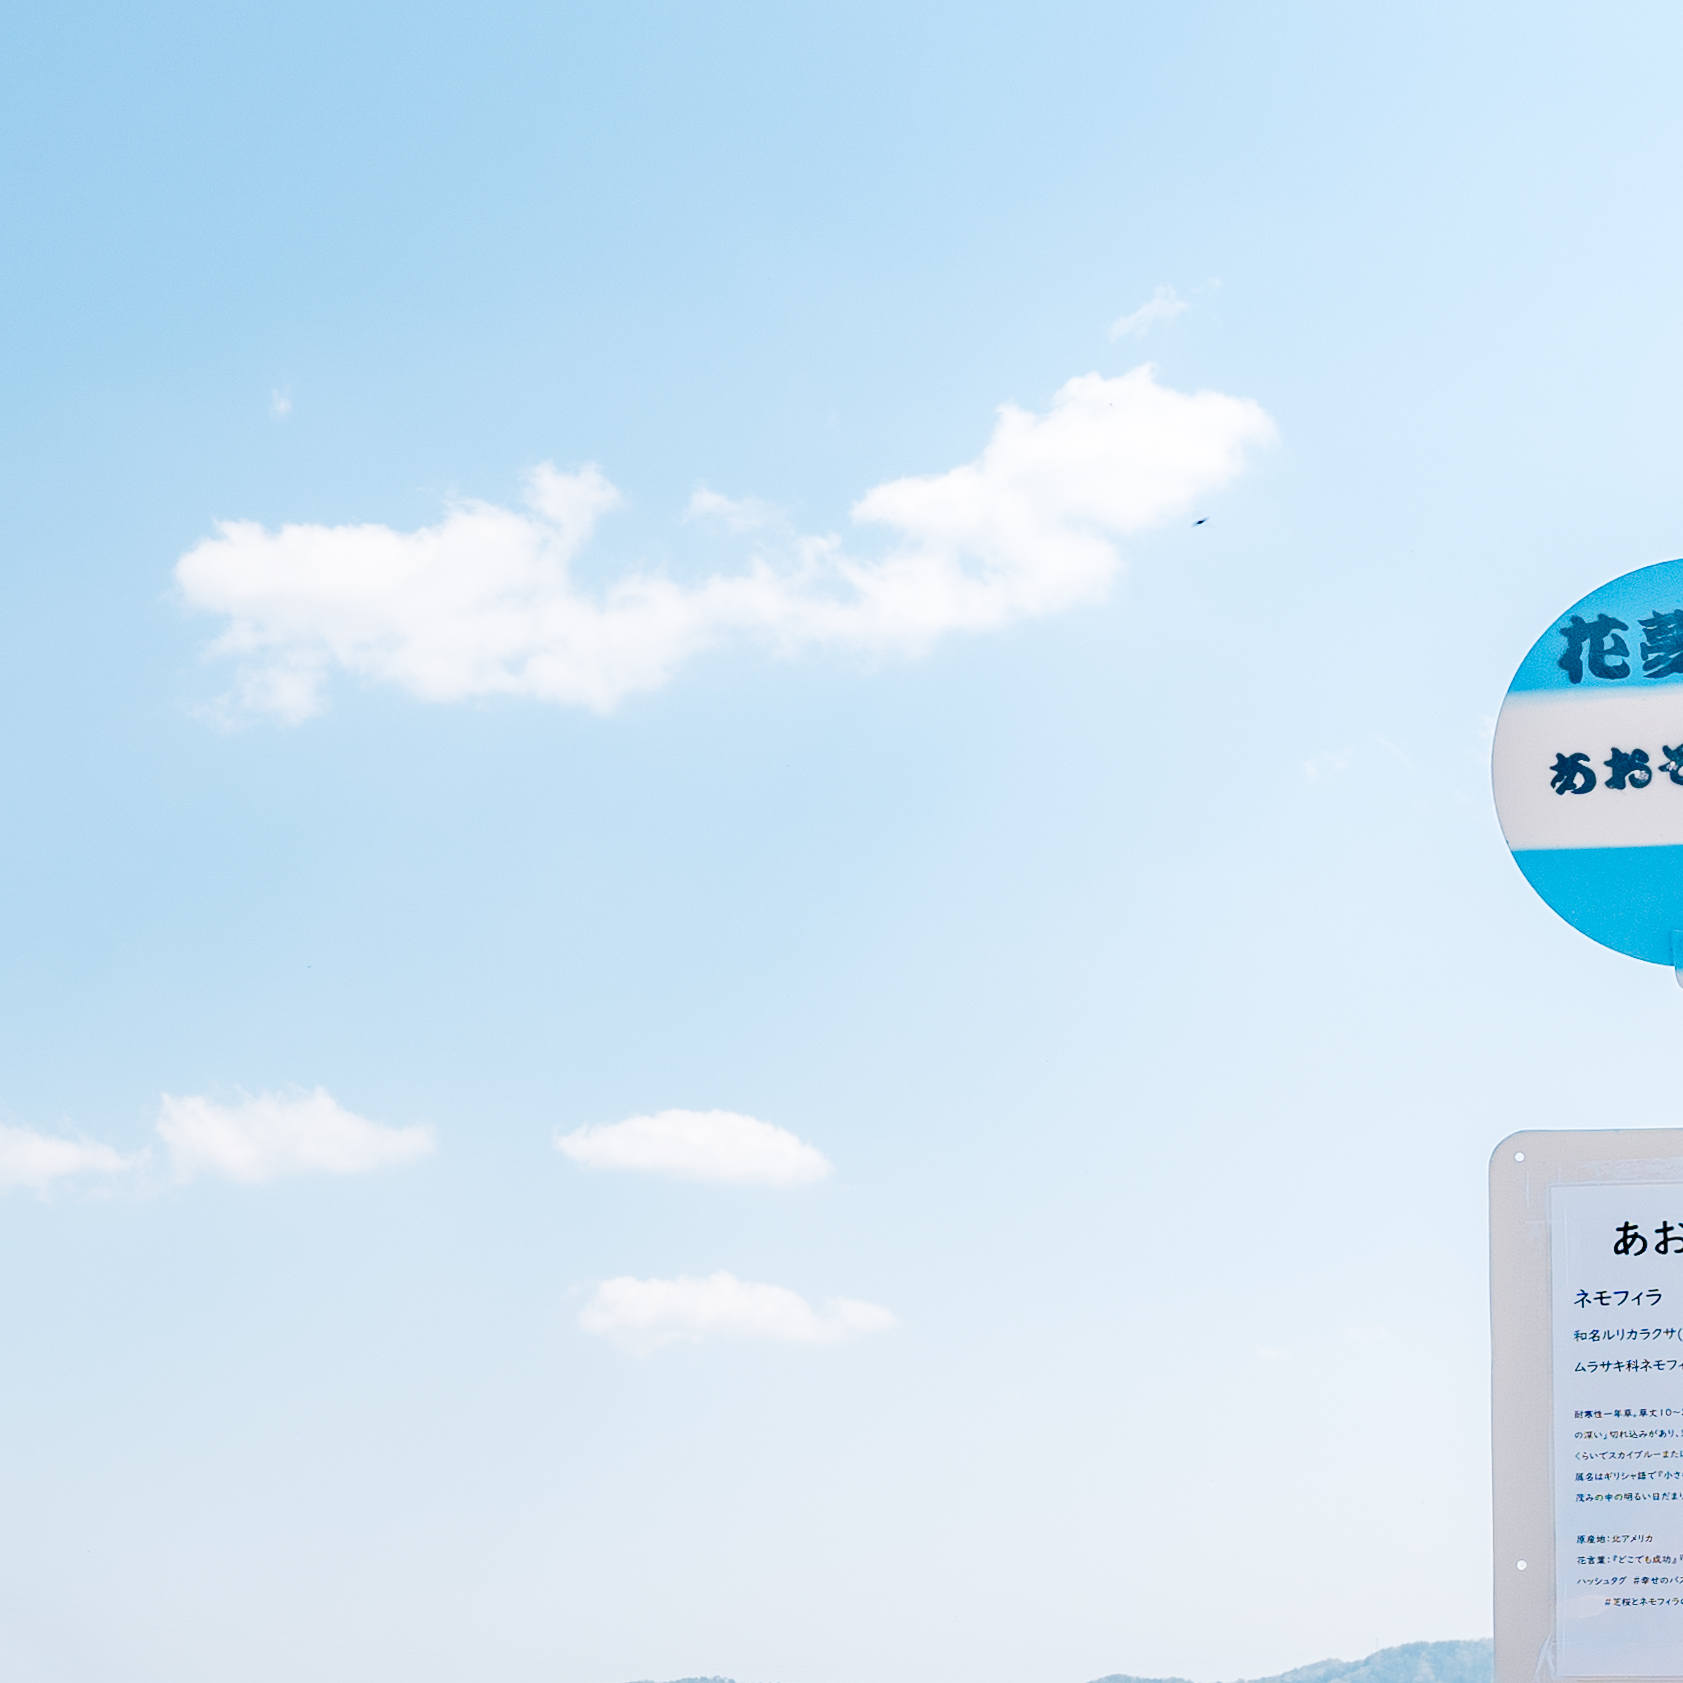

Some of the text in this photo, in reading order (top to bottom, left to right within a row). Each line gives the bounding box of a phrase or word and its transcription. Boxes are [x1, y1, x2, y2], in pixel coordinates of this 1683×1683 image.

[1573, 1288, 1663, 1309] ネモフィラ
[1576, 1575, 1628, 1586] ハッシュタグ
